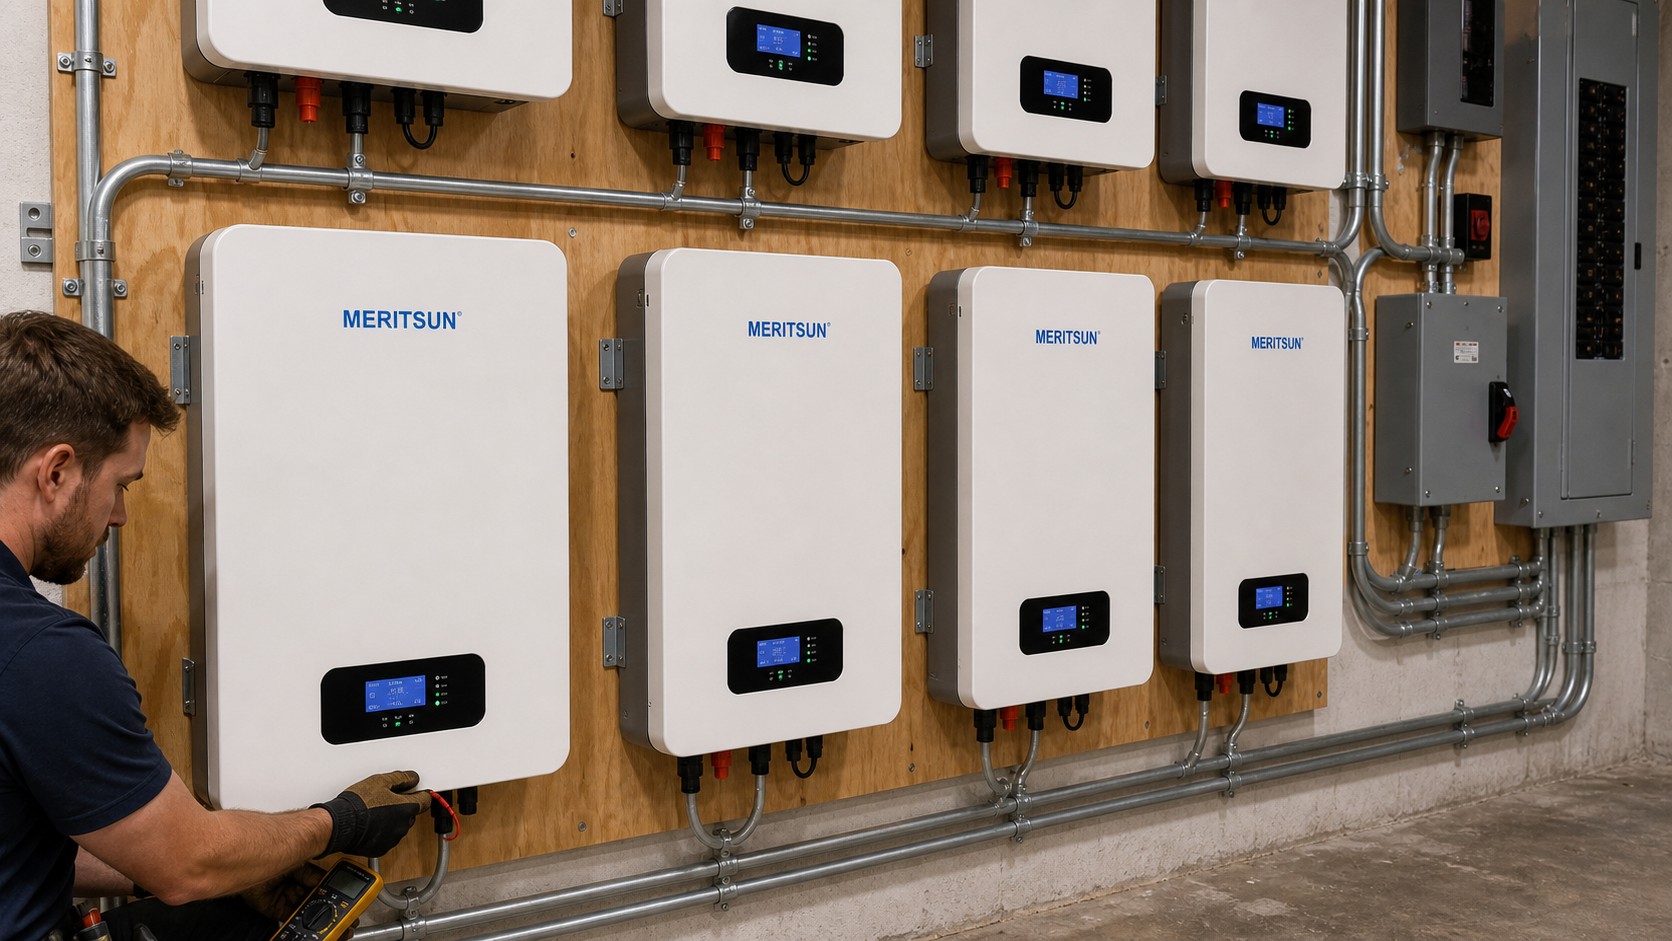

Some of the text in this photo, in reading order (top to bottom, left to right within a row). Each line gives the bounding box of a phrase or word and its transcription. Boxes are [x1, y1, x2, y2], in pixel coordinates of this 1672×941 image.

[343, 310, 457, 330] MERITSUN
[748, 321, 827, 339] MERITSUN
[1036, 330, 1098, 345] MERITSUN
[1251, 337, 1302, 350] MERITSUN
